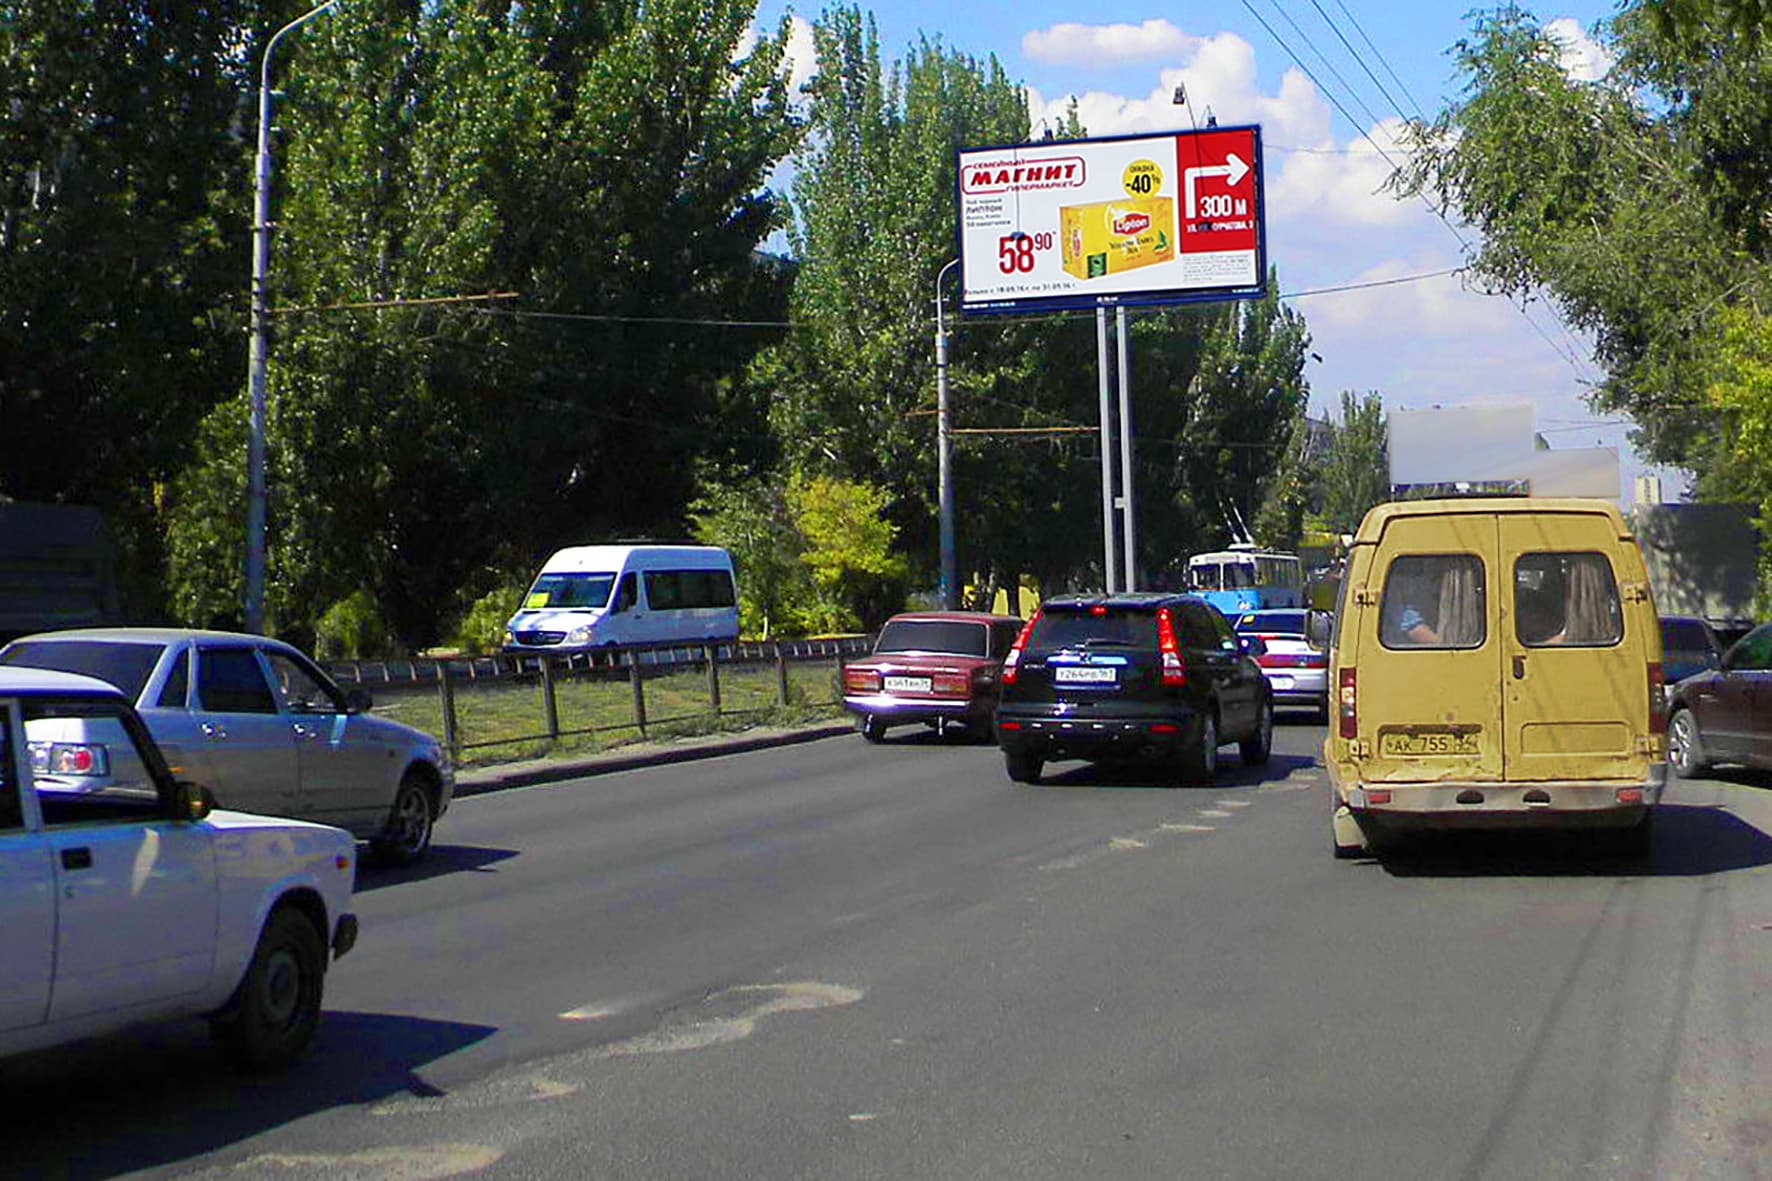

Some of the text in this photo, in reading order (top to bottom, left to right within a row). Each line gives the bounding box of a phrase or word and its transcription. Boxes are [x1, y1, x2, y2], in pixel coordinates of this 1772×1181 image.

[970, 164, 1077, 187] МАГНИТ
[1200, 194, 1232, 218] 300
[1115, 217, 1148, 233] Lipton
[999, 235, 1034, 274] 58
[1419, 736, 1448, 751] 755
